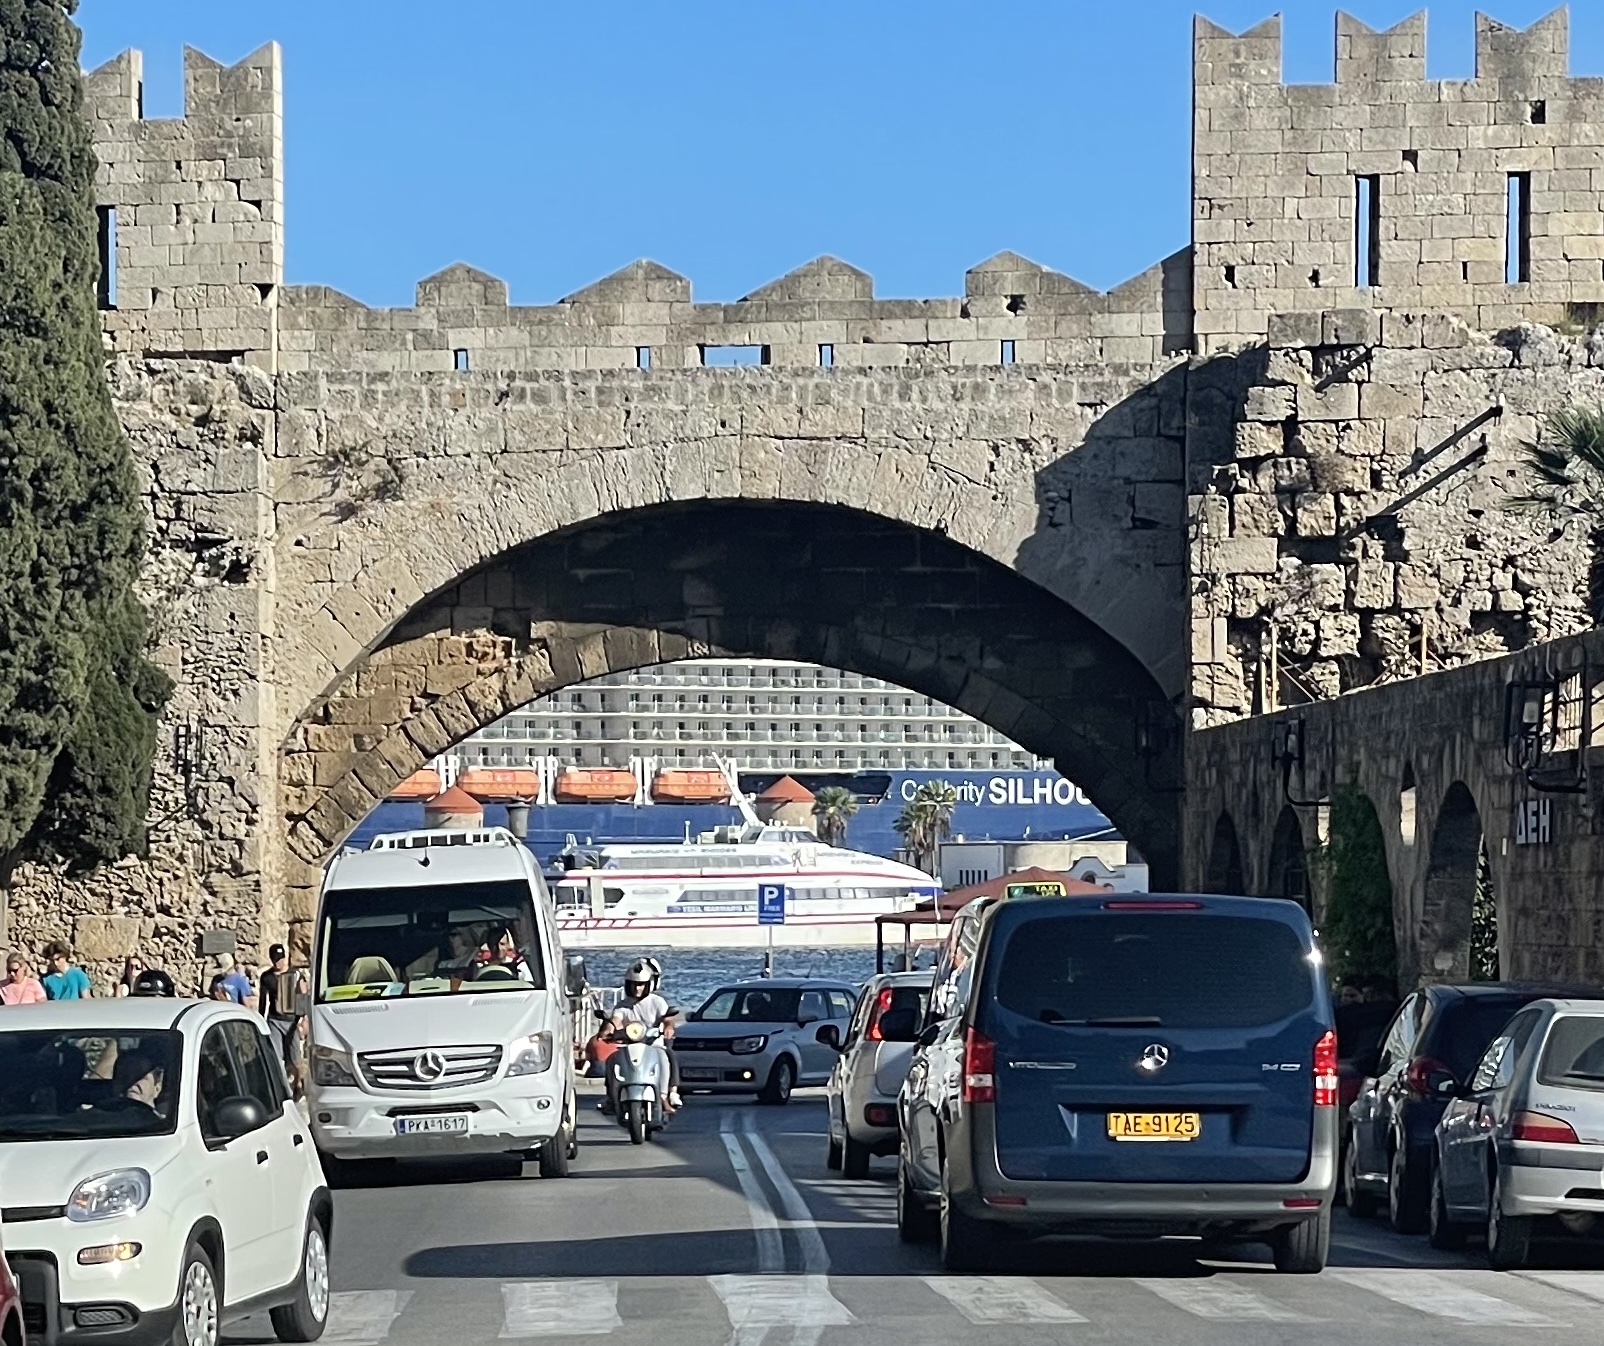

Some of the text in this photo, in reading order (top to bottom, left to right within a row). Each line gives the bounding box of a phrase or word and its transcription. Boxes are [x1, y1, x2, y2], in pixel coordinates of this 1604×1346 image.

[901, 779, 986, 806] Cbrity
[1516, 798, 1550, 844] ΔΕΗ
[764, 886, 779, 905] P
